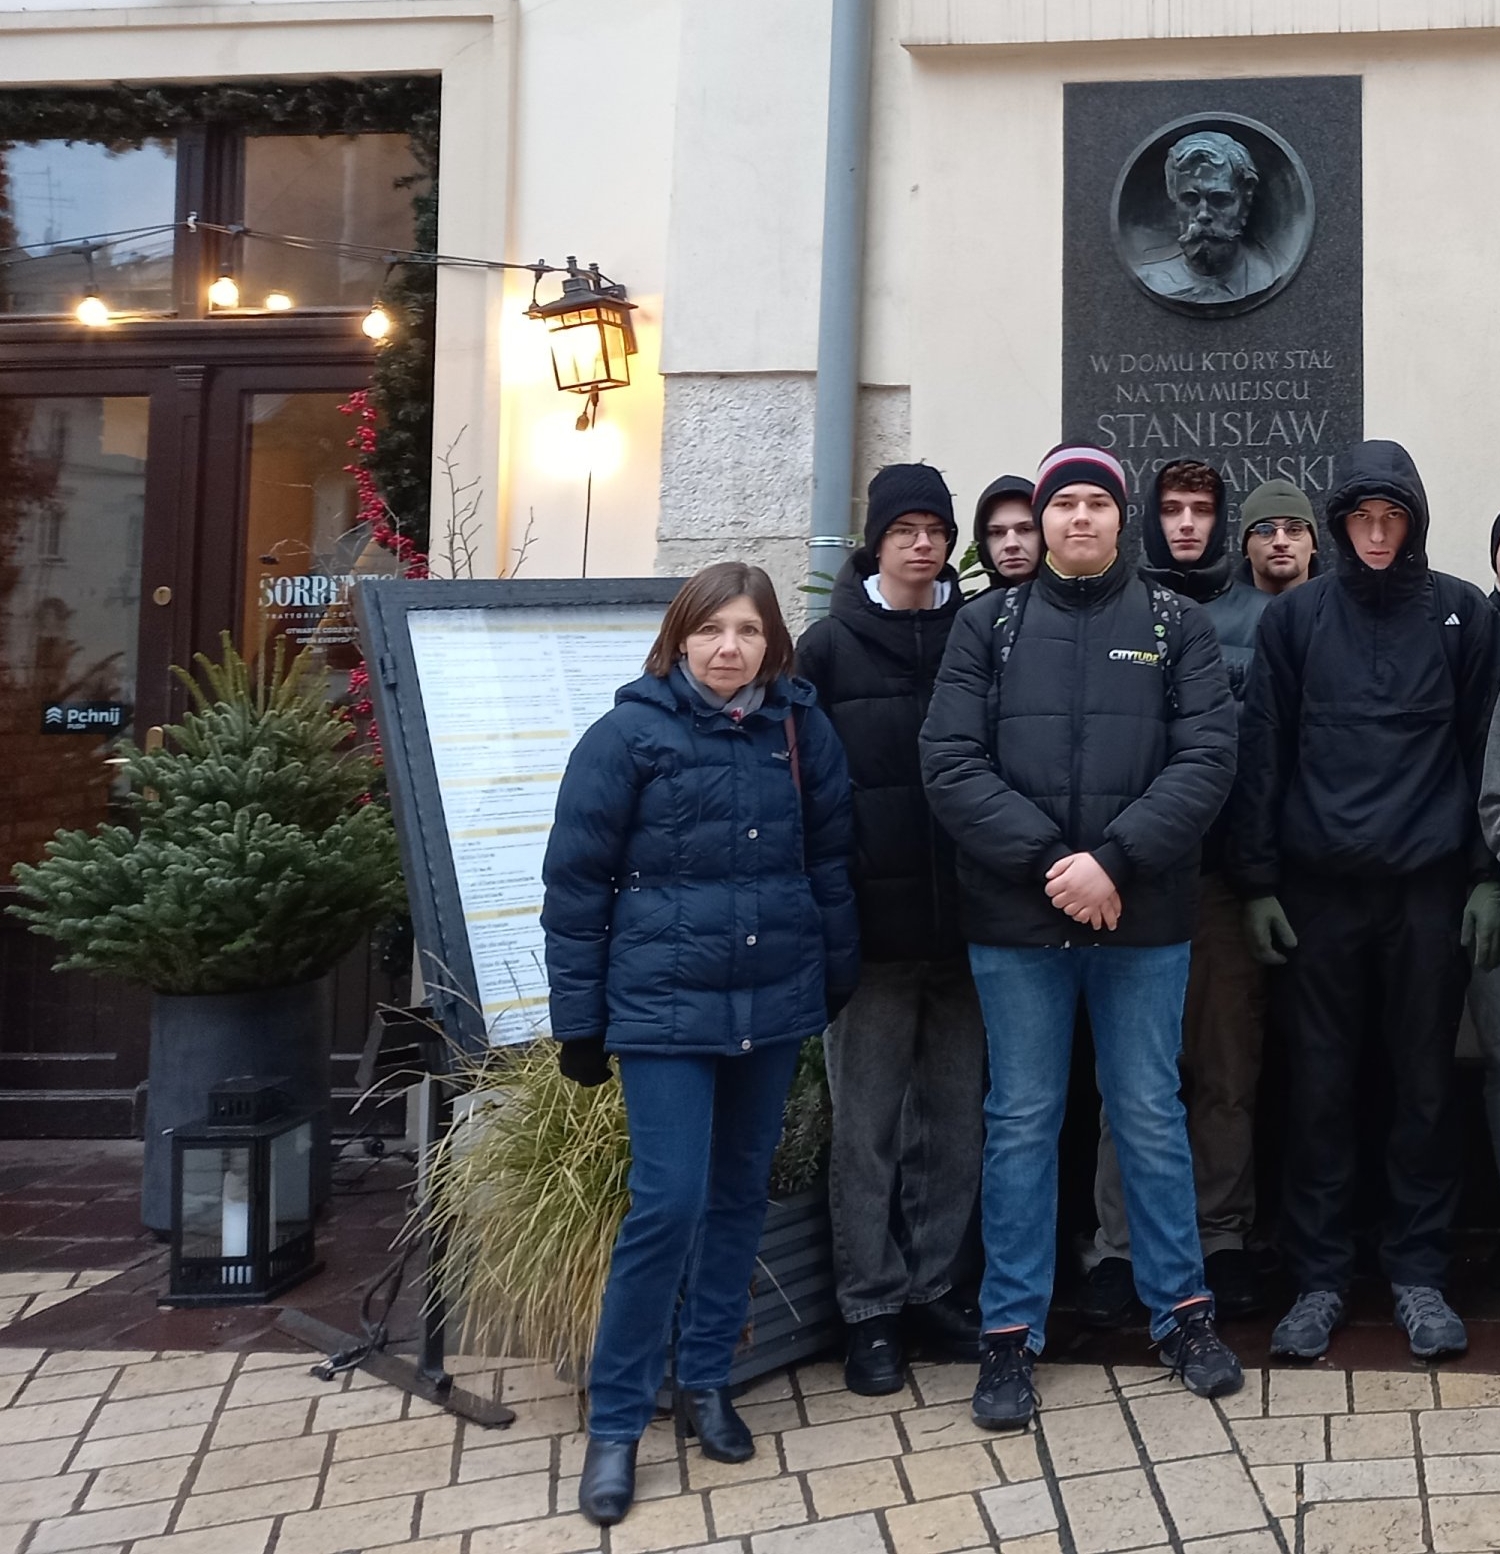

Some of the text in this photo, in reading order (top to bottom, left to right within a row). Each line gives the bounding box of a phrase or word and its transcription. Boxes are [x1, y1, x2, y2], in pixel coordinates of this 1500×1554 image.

[1090, 348, 1335, 373] W DOMU KTÓRY STAŁ
[1116, 380, 1311, 403] NA TYM MIEJSCU
[1097, 410, 1328, 449] STANISŁAW
[67, 707, 121, 727] Pchnij
